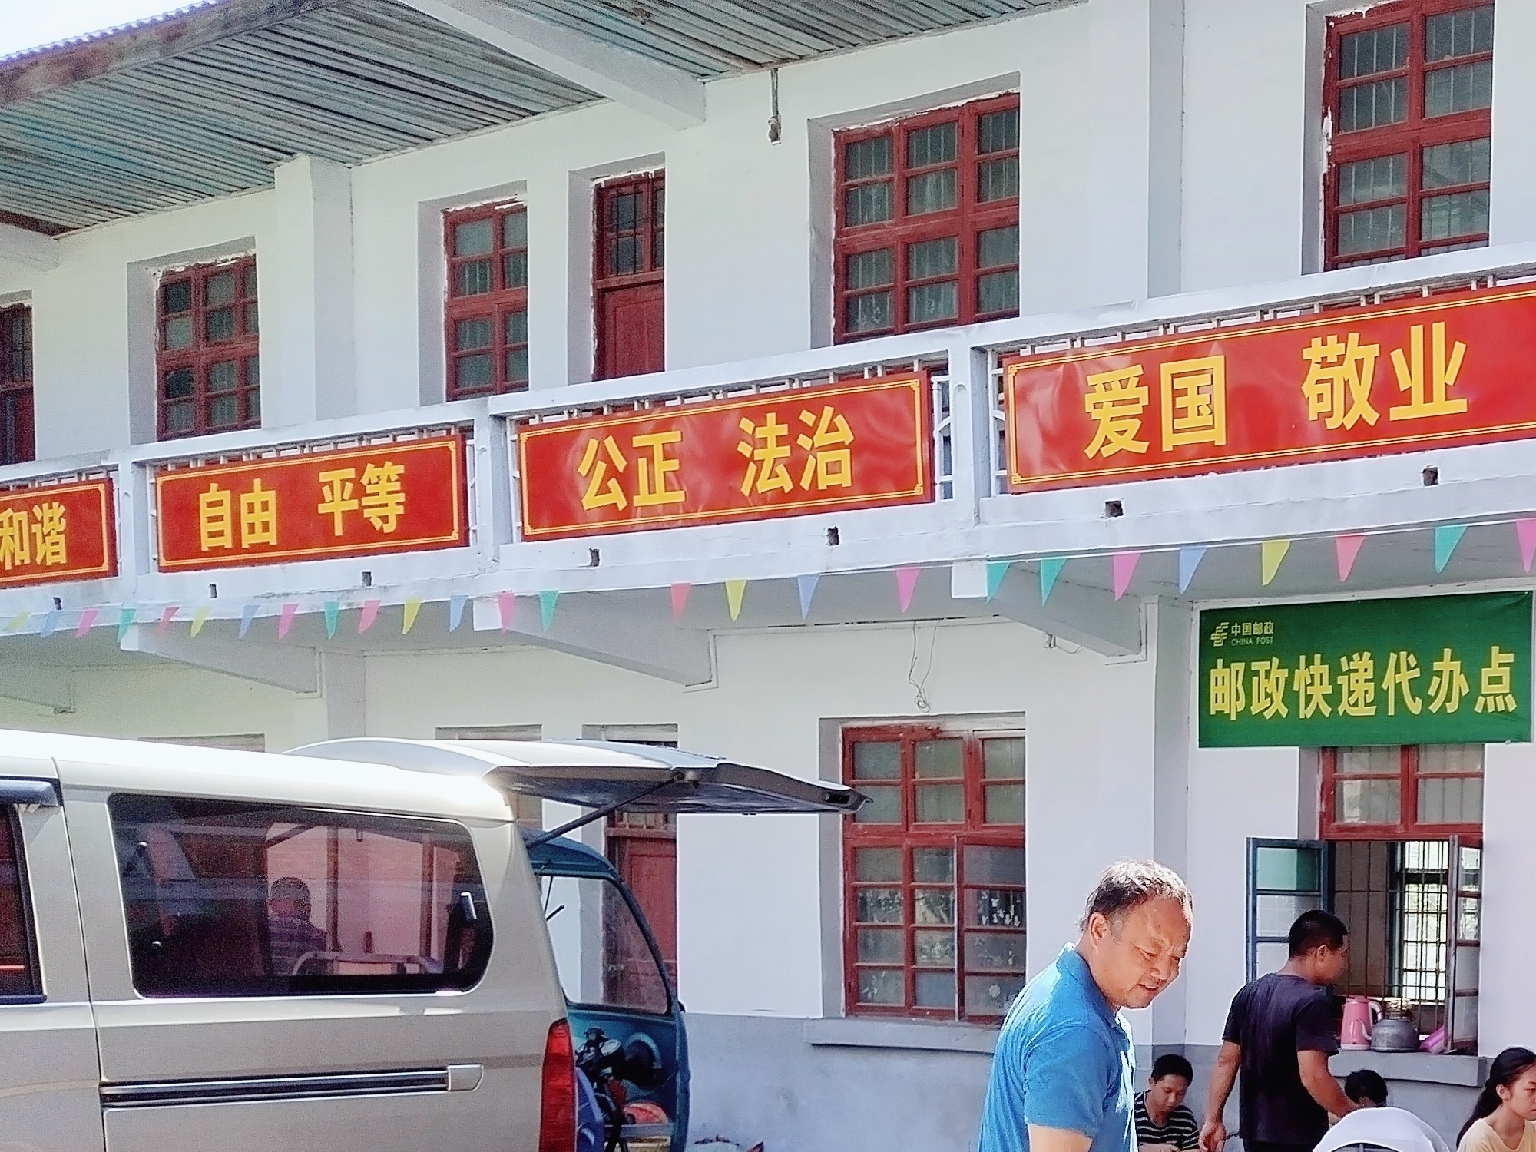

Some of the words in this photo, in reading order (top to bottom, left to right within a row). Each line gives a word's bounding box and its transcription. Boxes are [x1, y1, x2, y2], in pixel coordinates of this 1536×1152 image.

[1084, 356, 1228, 459] 爱国
[1302, 321, 1468, 431] 敬业
[577, 430, 686, 514] 公正
[736, 406, 855, 497] 法治
[0, 502, 67, 570] 和谐
[199, 482, 278, 553] 自由
[317, 462, 406, 537] 平等
[1231, 621, 1274, 636] 中国邮政
[1231, 637, 1253, 646] CHINA
[1256, 636, 1274, 645] POST
[1209, 646, 1518, 721] 邮政快递代办点
